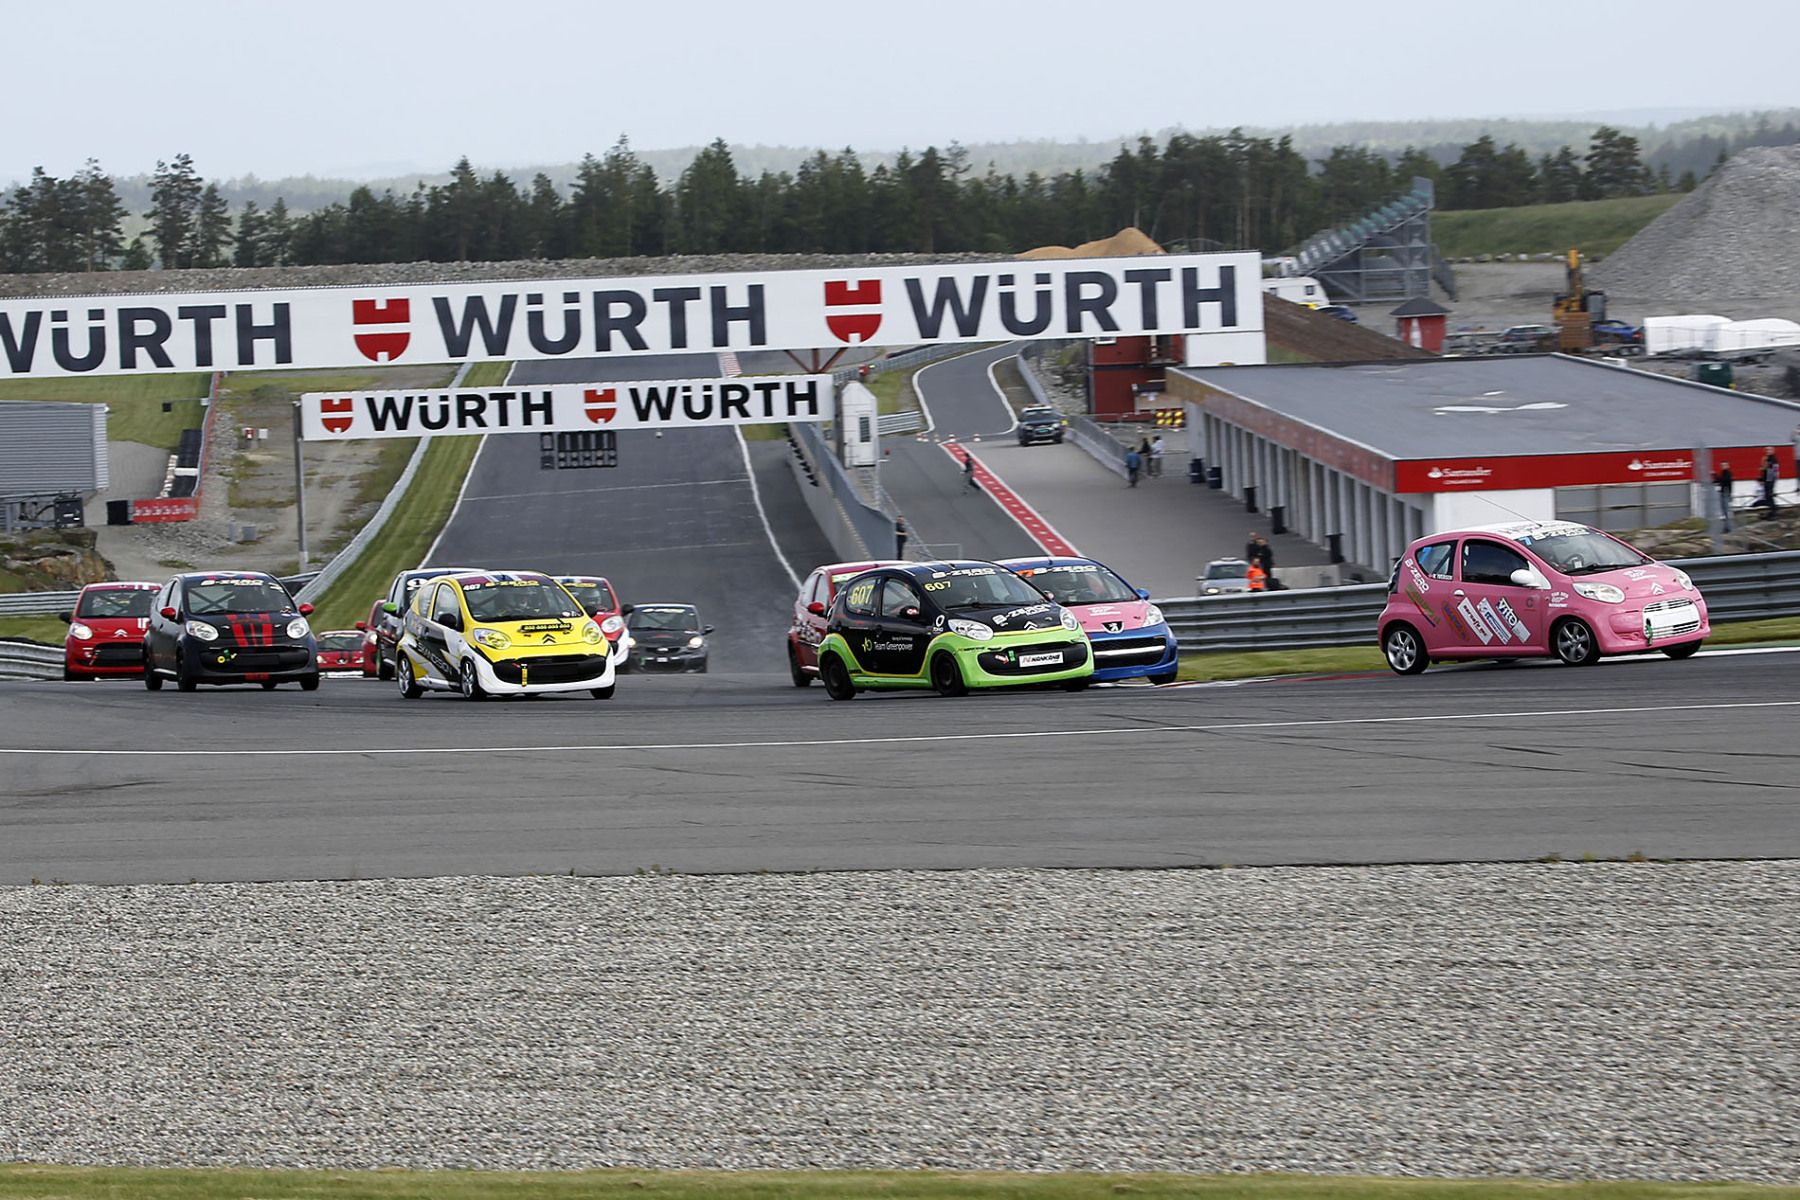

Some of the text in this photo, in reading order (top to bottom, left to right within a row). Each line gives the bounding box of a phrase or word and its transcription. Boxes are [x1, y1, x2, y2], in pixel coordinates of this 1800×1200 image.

[432, 283, 767, 359] WÜRTH
[904, 266, 1238, 340] WÜRTH
[365, 390, 554, 432] WÜRTH
[629, 380, 819, 422] WÜRTH
[851, 585, 875, 605] 607
[924, 581, 951, 591] 607
[873, 641, 886, 650] Team
